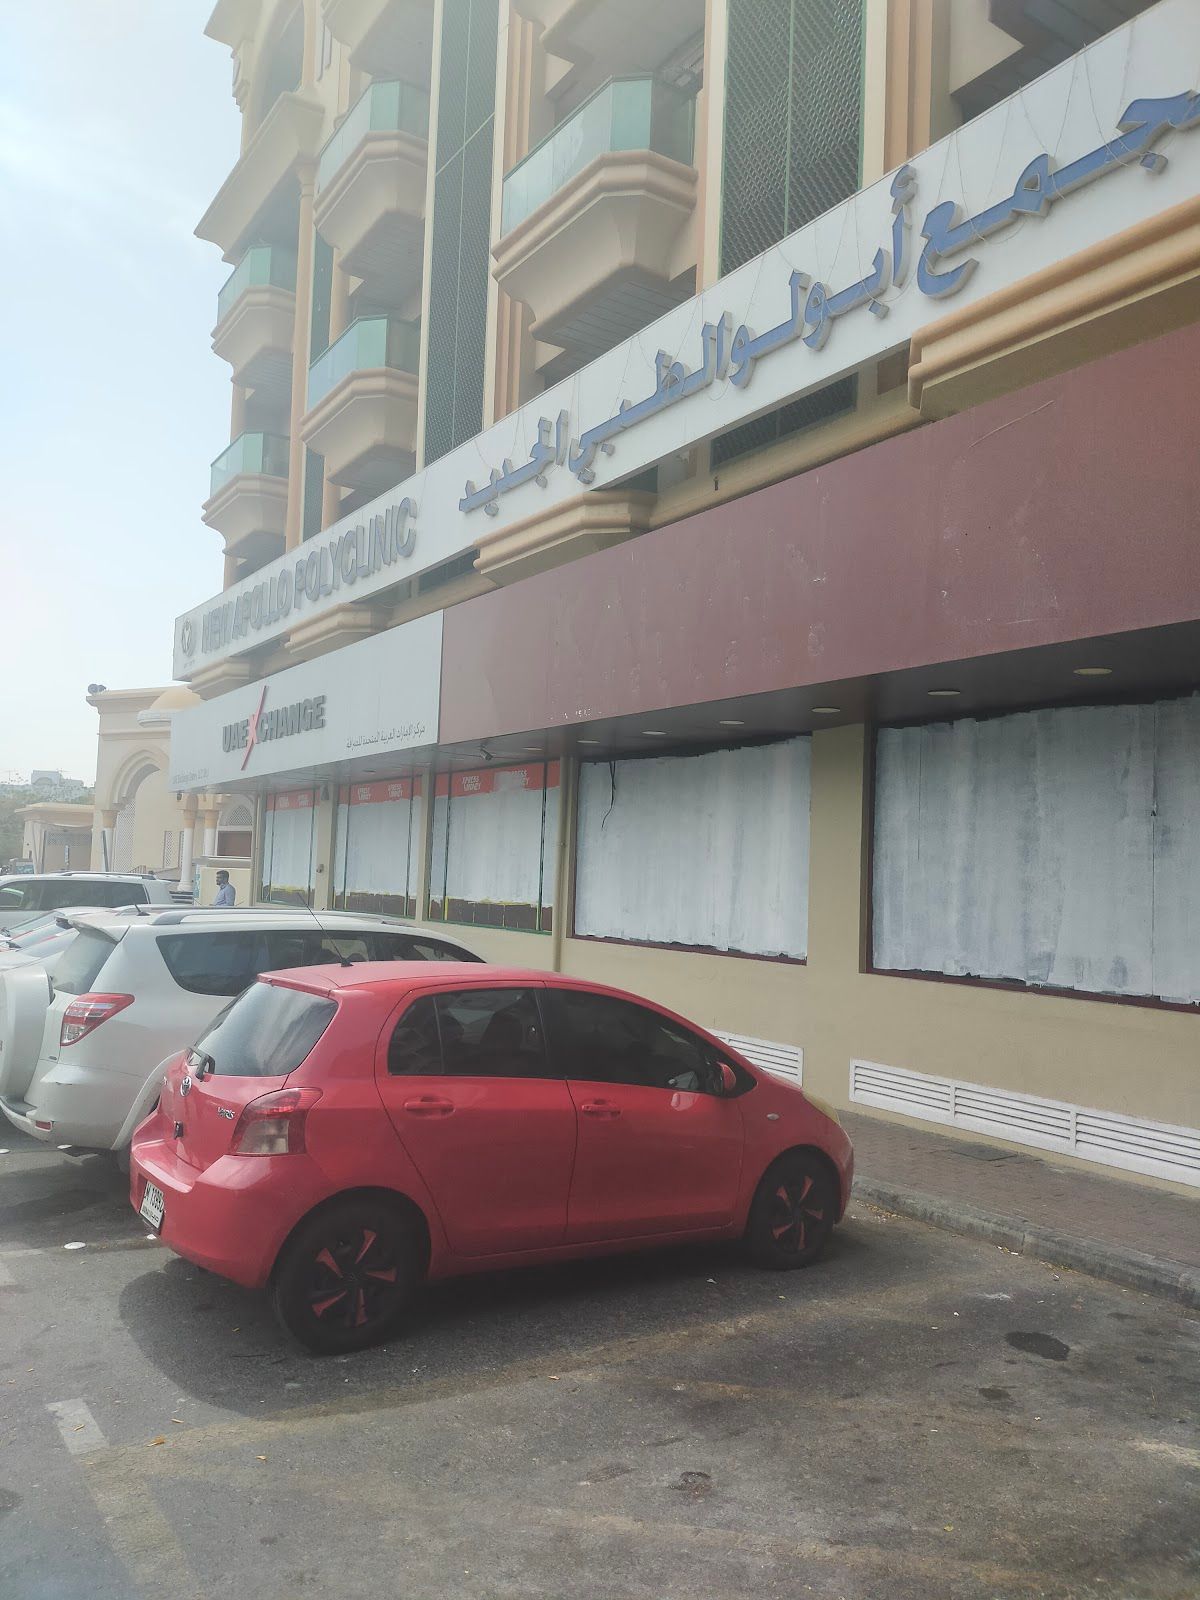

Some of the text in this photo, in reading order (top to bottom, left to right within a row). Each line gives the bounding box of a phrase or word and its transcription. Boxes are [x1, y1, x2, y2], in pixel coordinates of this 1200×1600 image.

[458, 88, 1200, 517] جمع أبولو الطبي الجديد
[201, 497, 417, 654] NEW APOLLO POLYCLINIC
